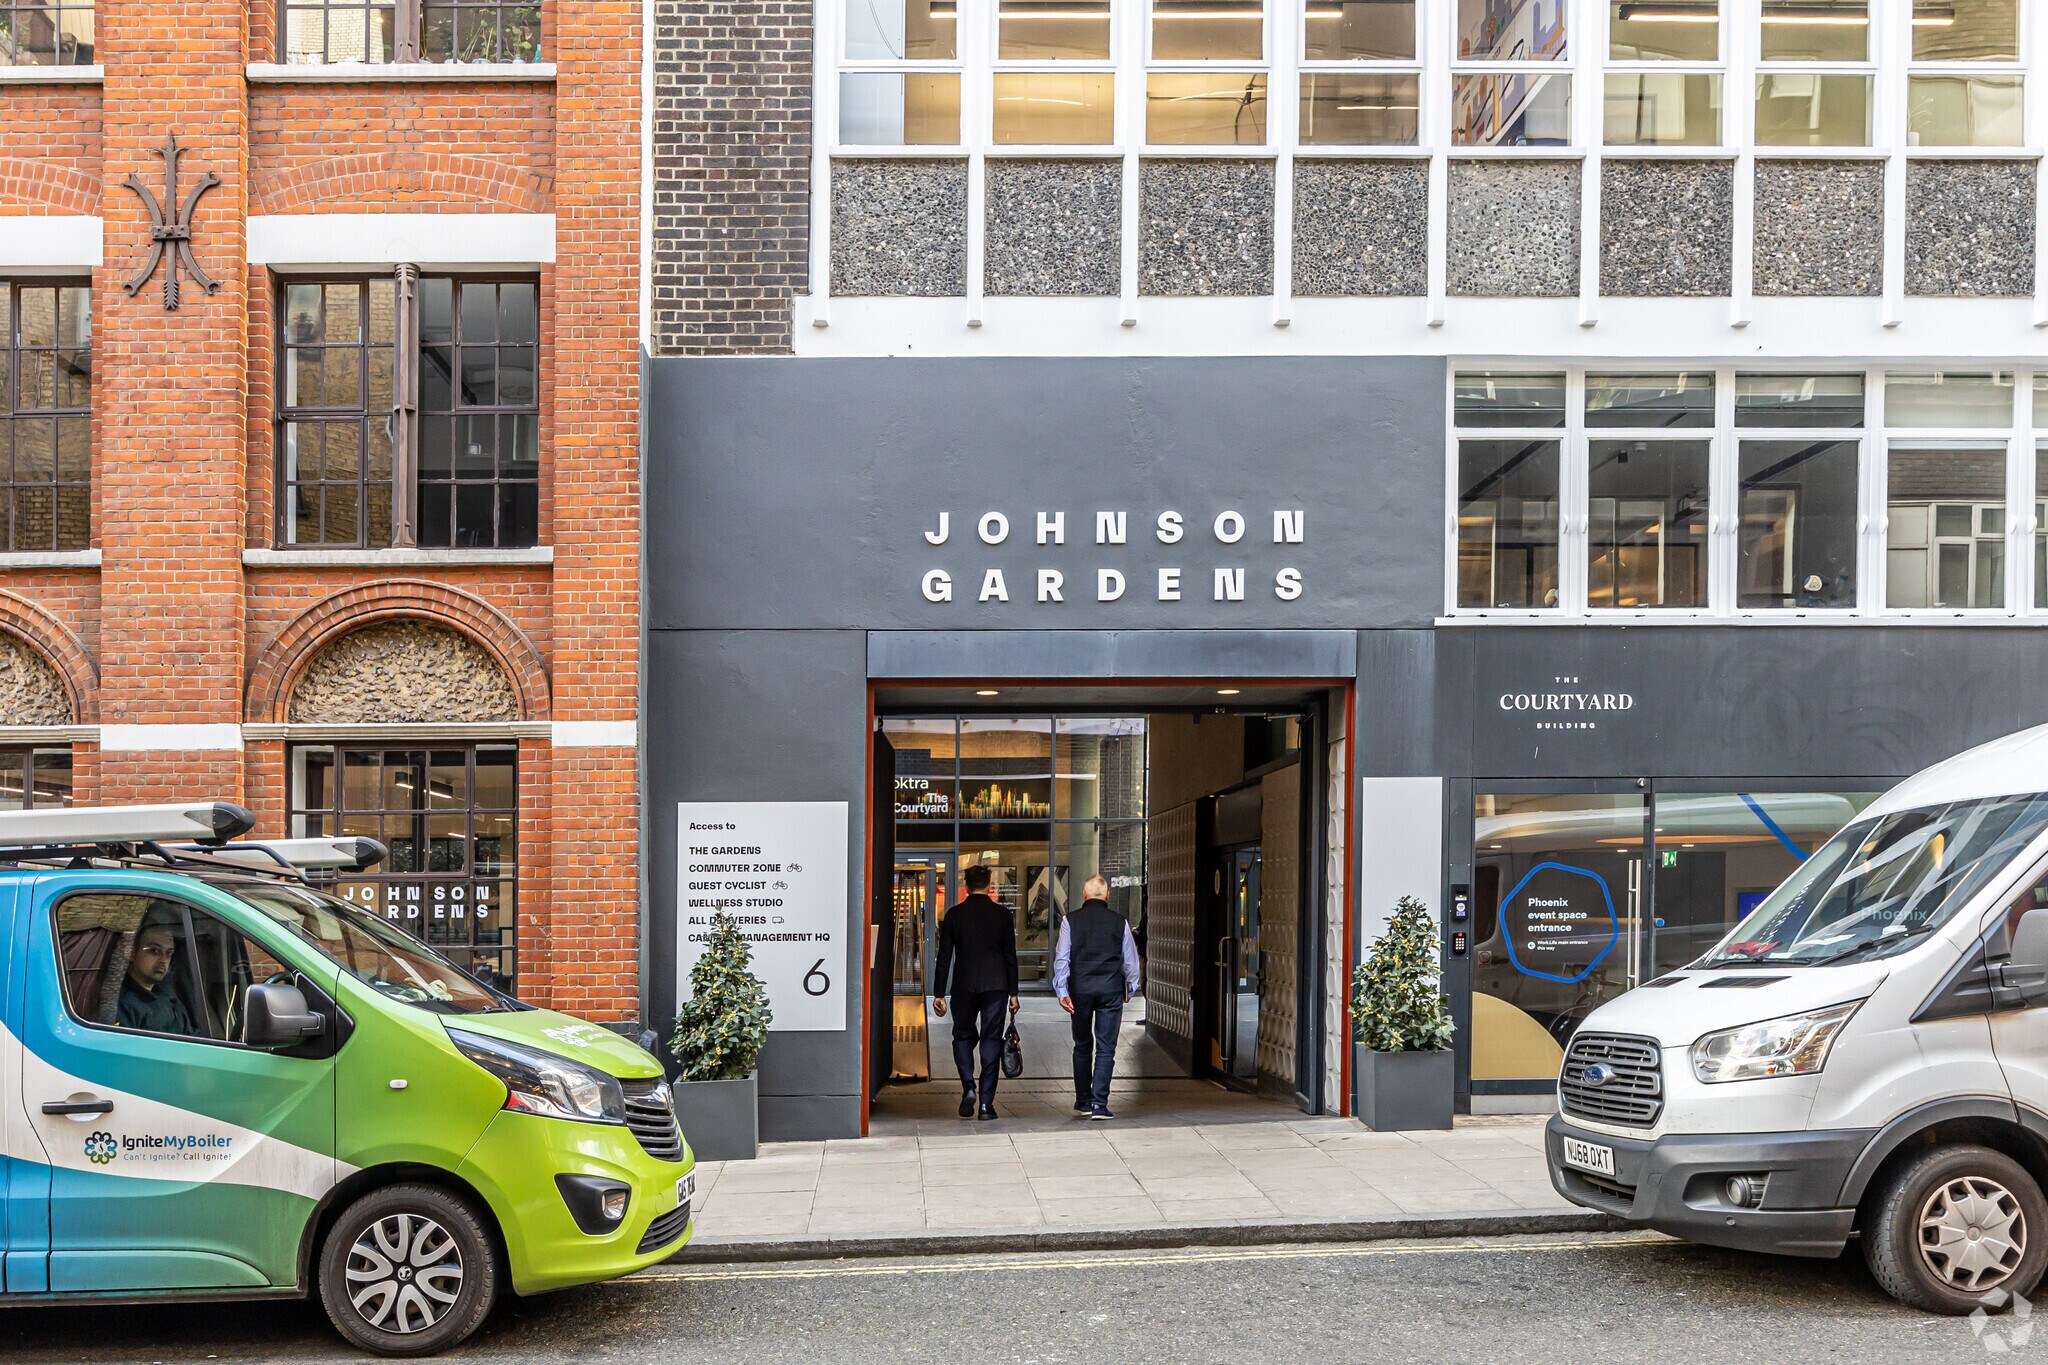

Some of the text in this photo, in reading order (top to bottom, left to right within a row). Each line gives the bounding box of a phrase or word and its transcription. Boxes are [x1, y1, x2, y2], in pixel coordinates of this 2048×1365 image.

[924, 510, 1304, 545] JOHNSON
[921, 567, 1302, 602] GARDENS
[1555, 676, 1579, 684] THE
[1499, 693, 1634, 711] COURTYARD
[927, 792, 948, 803] The
[894, 802, 949, 815] Courtyard
[689, 822, 736, 830] Access to
[689, 846, 761, 855] THE GARDENS
[689, 864, 781, 873] COMMUTER ZONE
[688, 881, 767, 890] GUEST CYCLIST
[343, 886, 490, 901] JOHNSON
[688, 898, 784, 908] WELLNESS STUDIO
[1528, 897, 1569, 907] Phoenix
[362, 904, 489, 919] RDENS
[1528, 911, 1588, 922] event space
[688, 916, 767, 925] ALL DVERIES
[1528, 924, 1573, 932] entrance
[815, 933, 831, 942] HQ
[803, 958, 830, 996] 6
[122, 1134, 233, 1151] IgniteMyBoiler
[123, 1152, 232, 1162] Can't Ignite? Call Ignite!
[1590, 1146, 1609, 1170] OXT
